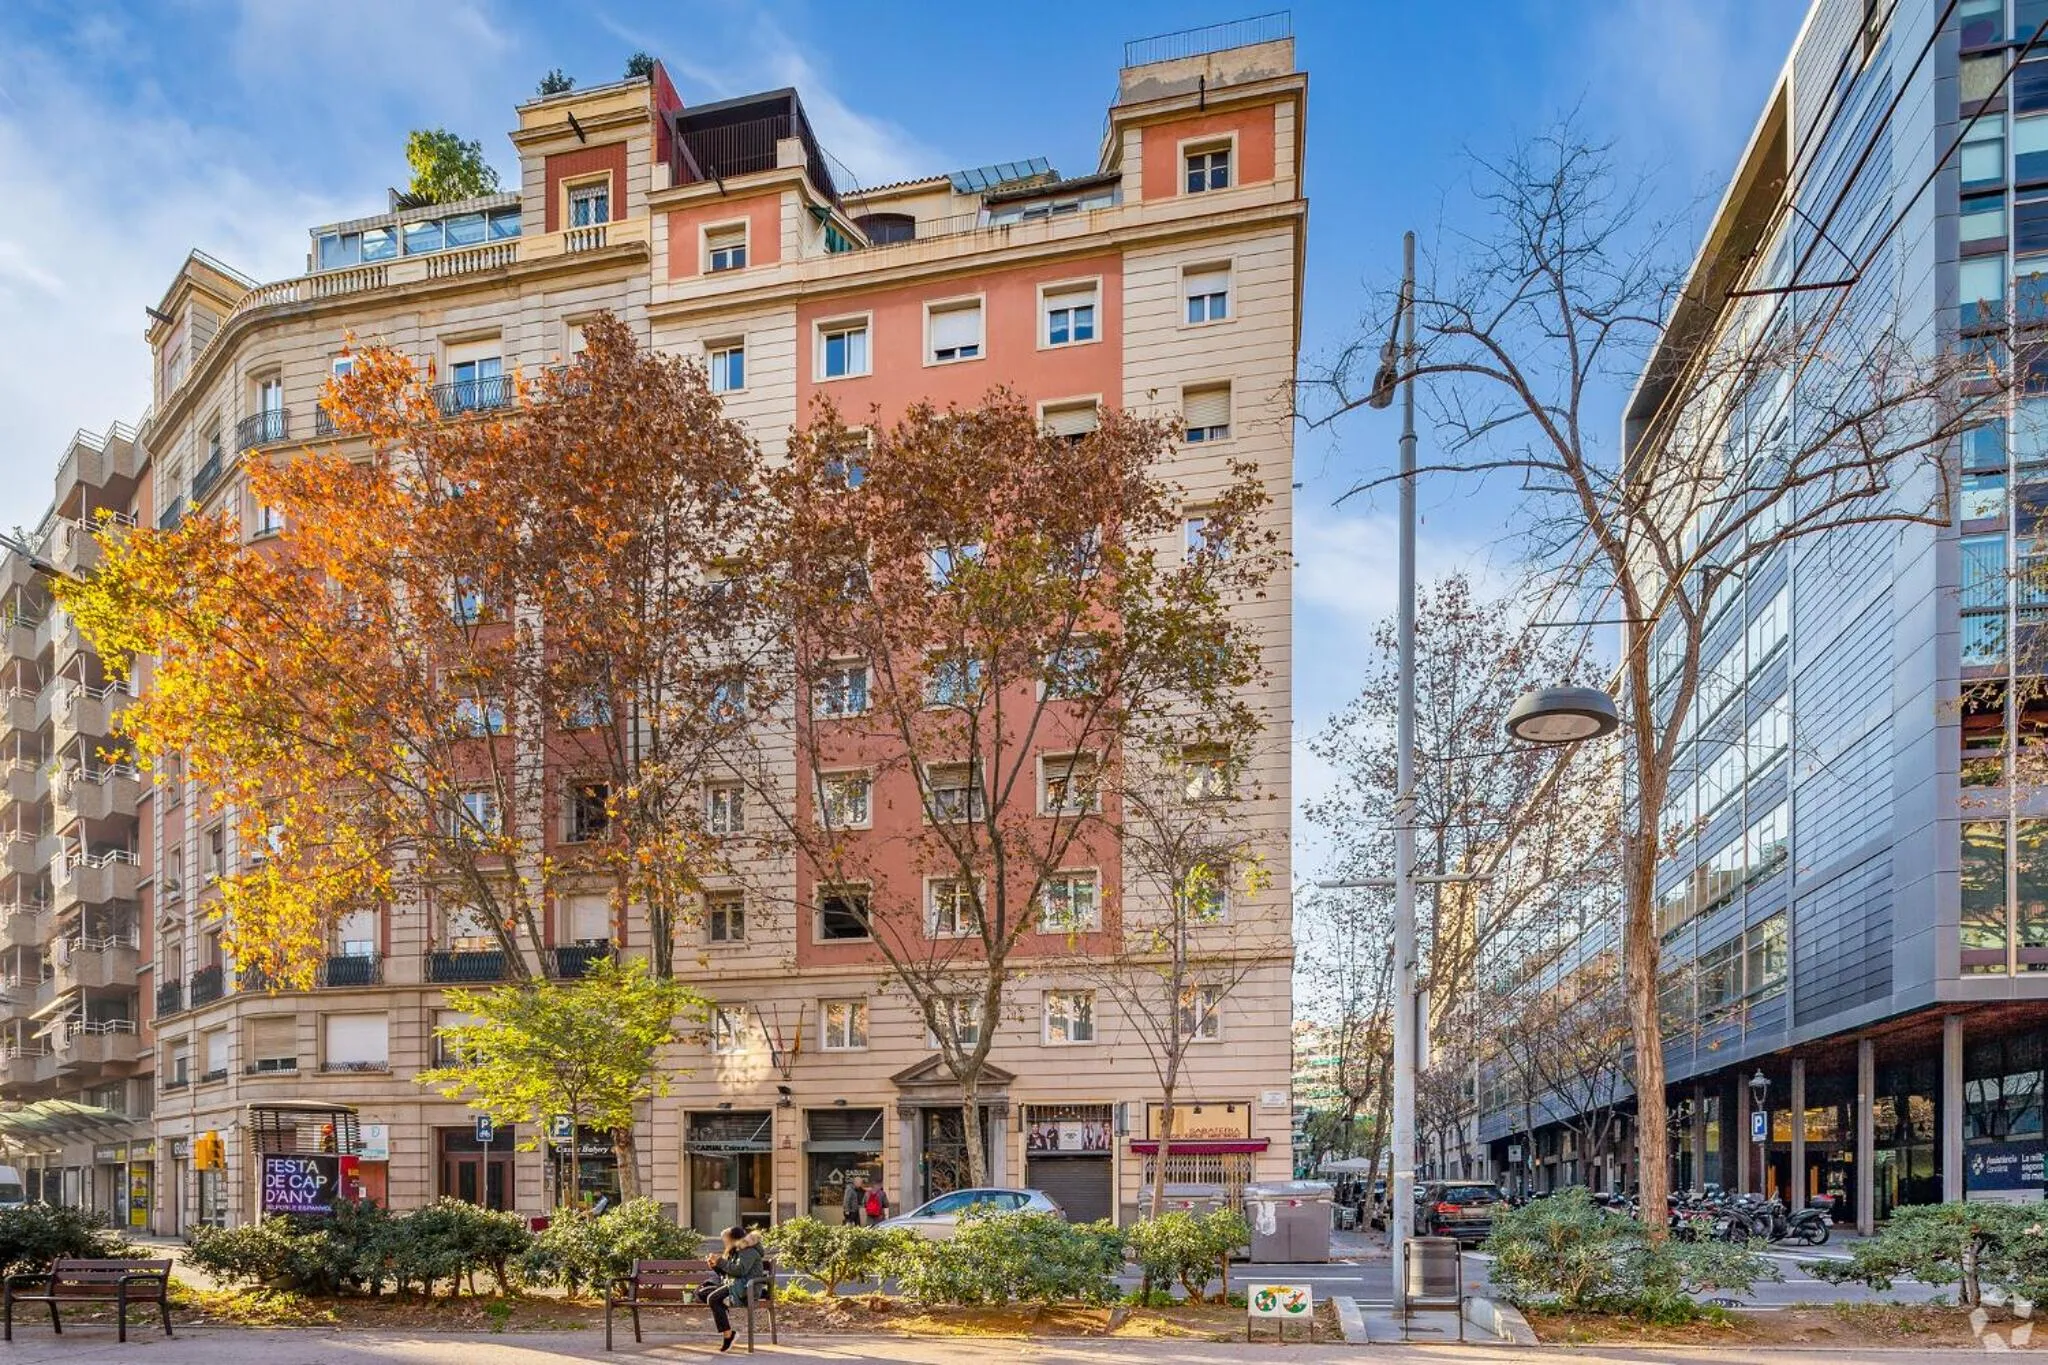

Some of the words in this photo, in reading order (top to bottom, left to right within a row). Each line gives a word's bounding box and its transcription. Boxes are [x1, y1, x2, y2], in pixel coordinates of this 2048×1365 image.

[481, 1119, 489, 1129] P
[554, 1116, 570, 1135] P
[1754, 1115, 1763, 1133] P
[266, 1159, 319, 1174] FESTA
[266, 1174, 286, 1189] DE
[289, 1174, 328, 1189] CAP
[266, 1189, 317, 1204] D'ANY
